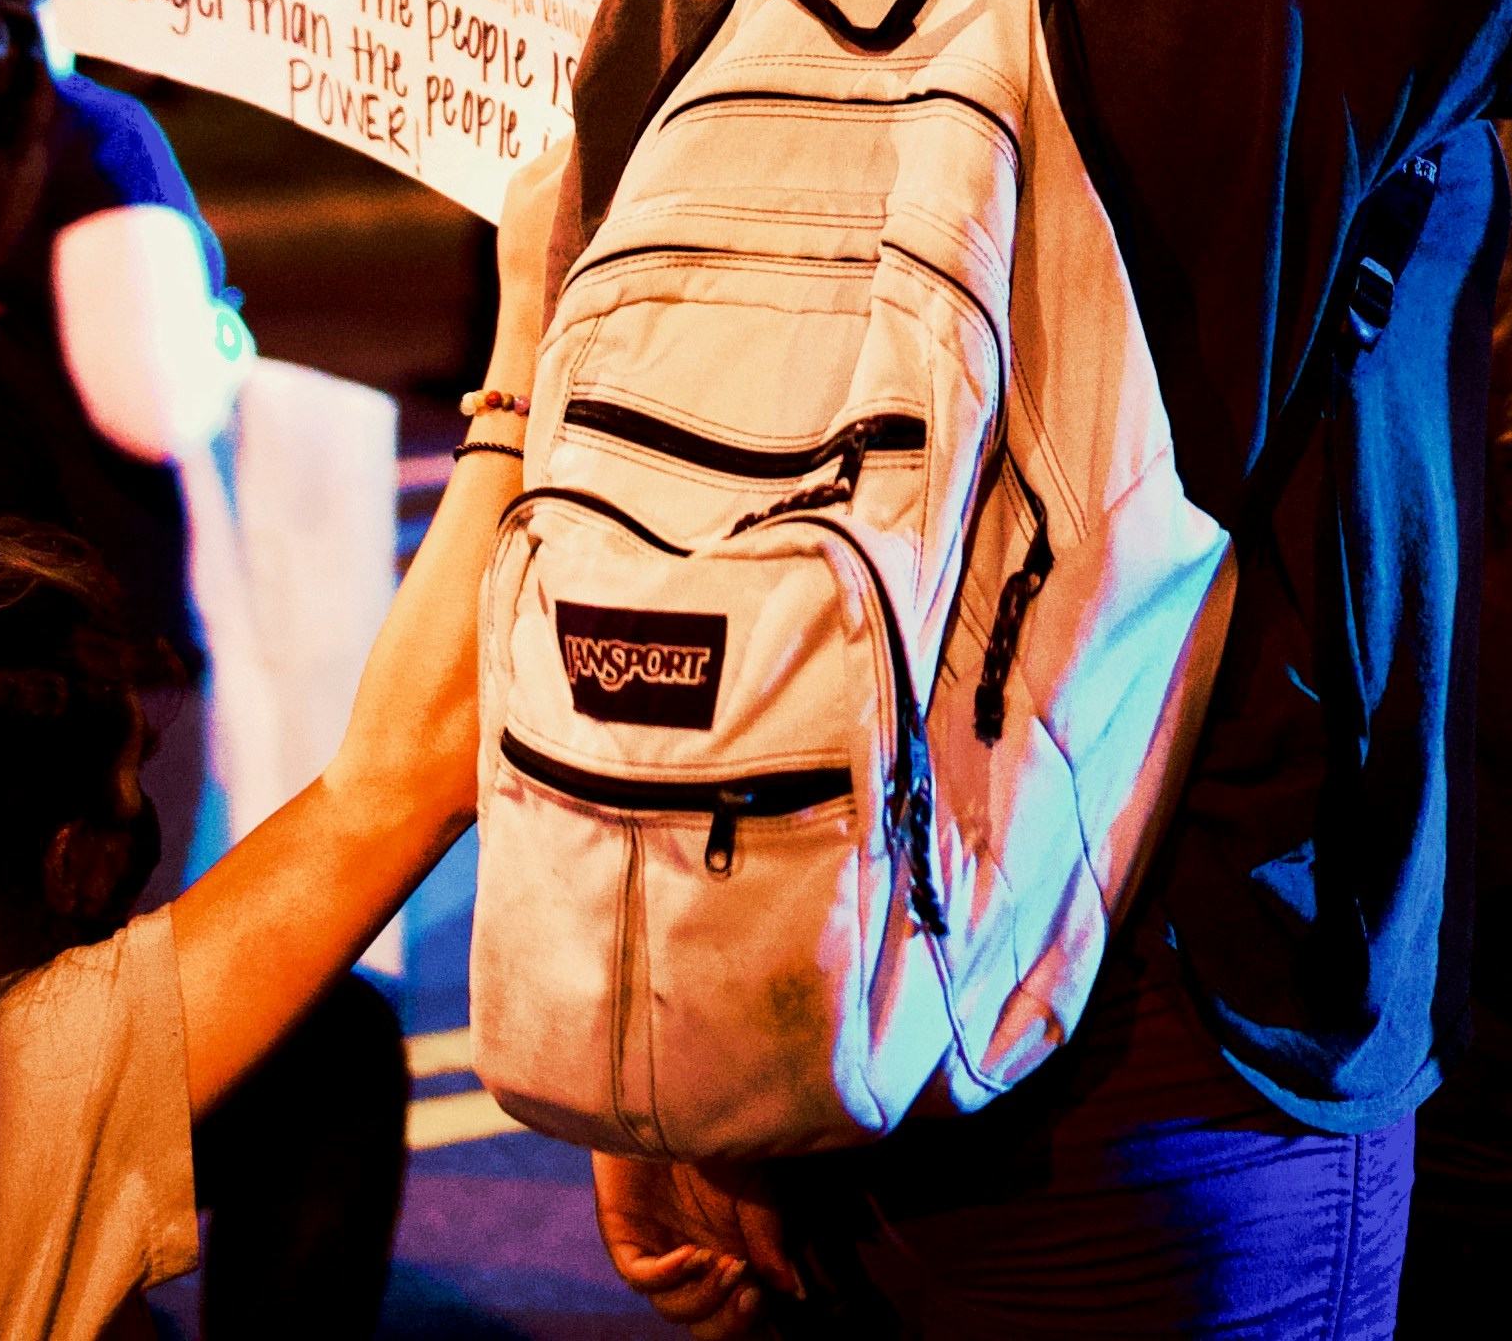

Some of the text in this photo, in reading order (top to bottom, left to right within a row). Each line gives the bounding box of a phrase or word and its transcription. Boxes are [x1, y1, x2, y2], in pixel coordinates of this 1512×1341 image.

[288, 57, 421, 175] POWER!
[348, 25, 408, 98] the
[426, 74, 521, 159] people
